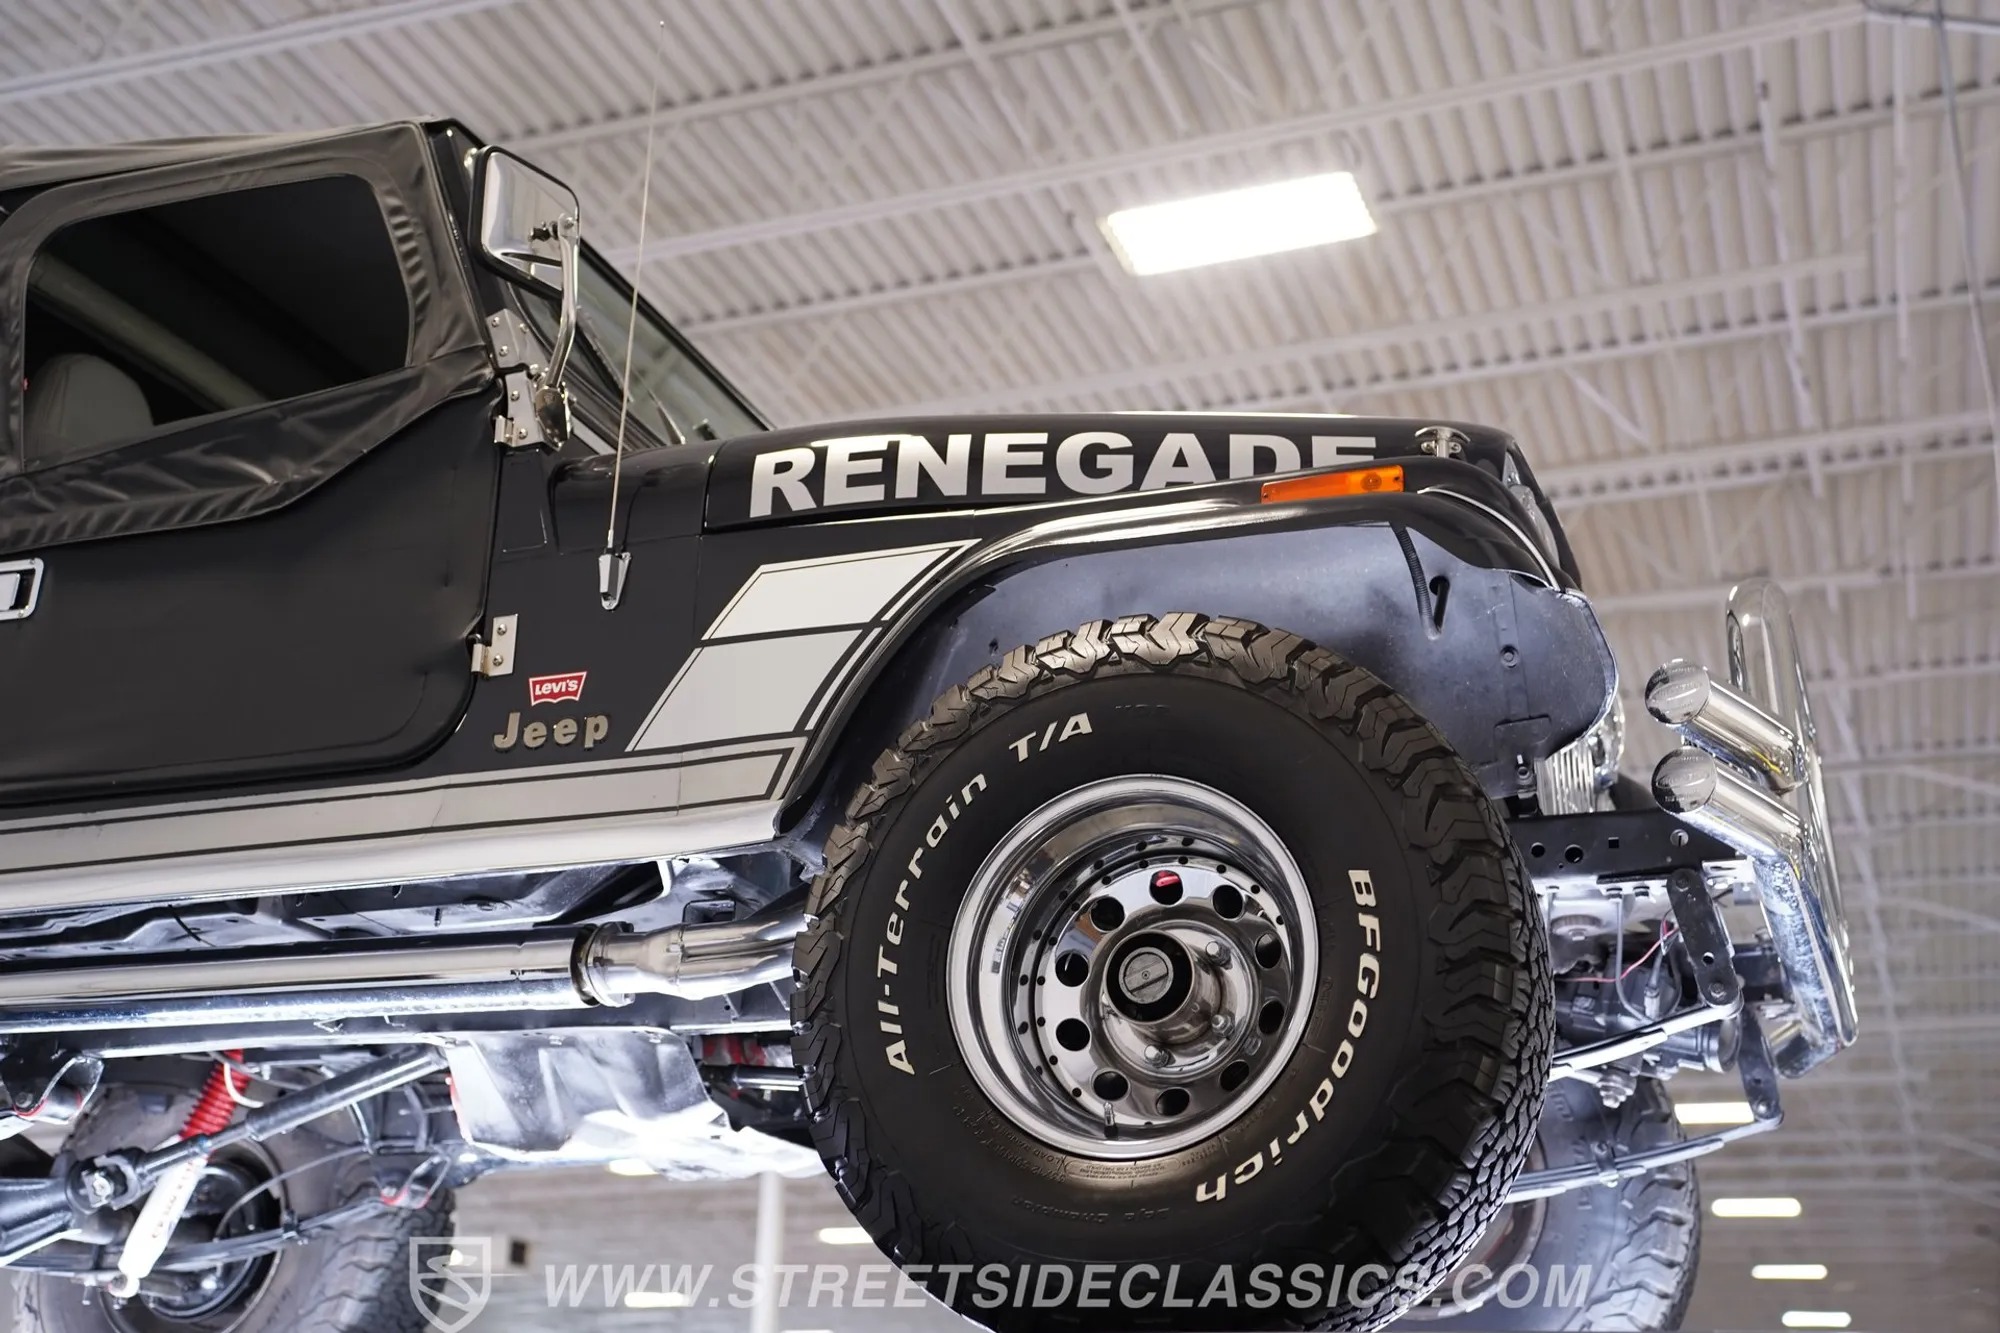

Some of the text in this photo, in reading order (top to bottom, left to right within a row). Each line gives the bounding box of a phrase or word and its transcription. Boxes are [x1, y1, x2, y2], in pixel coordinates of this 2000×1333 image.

[493, 711, 609, 749] Jeep
[876, 772, 987, 1076] All-Terrain
[1008, 712, 1093, 763] T/A
[1195, 869, 1381, 1203] BFGoodrich
